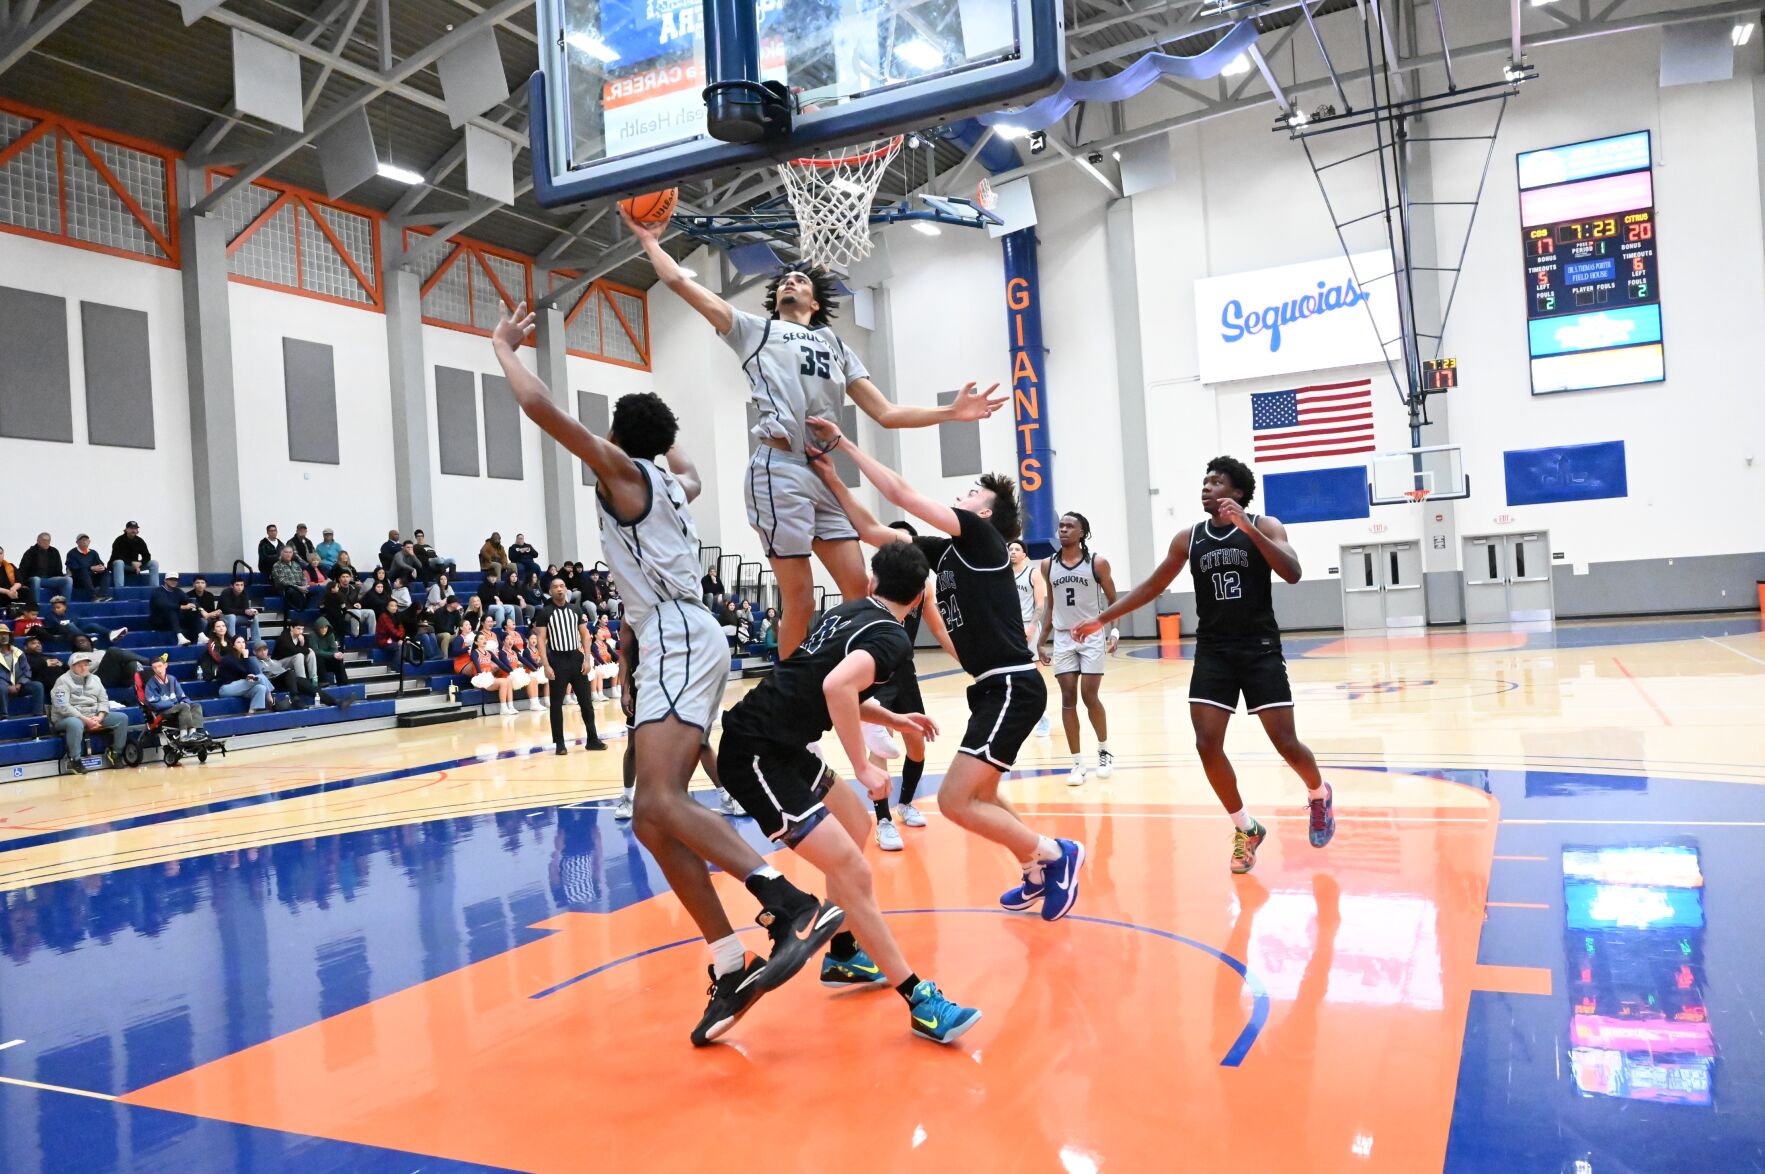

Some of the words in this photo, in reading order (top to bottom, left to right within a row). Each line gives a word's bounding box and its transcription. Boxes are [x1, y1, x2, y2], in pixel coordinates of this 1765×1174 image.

[1624, 213, 1649, 224] CITRUS
[1571, 219, 1616, 239] 7:23
[1628, 222, 1652, 241] 20
[1537, 238, 1553, 255] 17
[1571, 246, 1594, 254] PERIOD
[1600, 240, 1605, 254] 1
[1621, 242, 1642, 250] BONUS
[1537, 254, 1557, 263] BONUS
[1622, 250, 1653, 260] TIMEOUTS
[1528, 264, 1557, 274] TIMEOUTS
[1633, 258, 1644, 271] 6
[1537, 271, 1548, 284] 5
[1628, 278, 1646, 286] FOULS
[1537, 283, 1550, 291] LEFT
[1572, 285, 1594, 294] PLAYER
[1597, 282, 1615, 290] FOULS
[1638, 284, 1648, 298] 2
[1537, 291, 1554, 299] FOULS
[1545, 297, 1554, 310] 2
[1221, 277, 1371, 353] Sequoias
[800, 345, 831, 380] 35
[1430, 358, 1456, 370] 7:23
[1007, 277, 1043, 492] GIANTS
[1435, 370, 1453, 388] 17
[1200, 547, 1249, 573] CITRUS
[1052, 575, 1089, 589] SEQUOIAS
[1211, 570, 1242, 600] 12
[1065, 587, 1076, 607] 2
